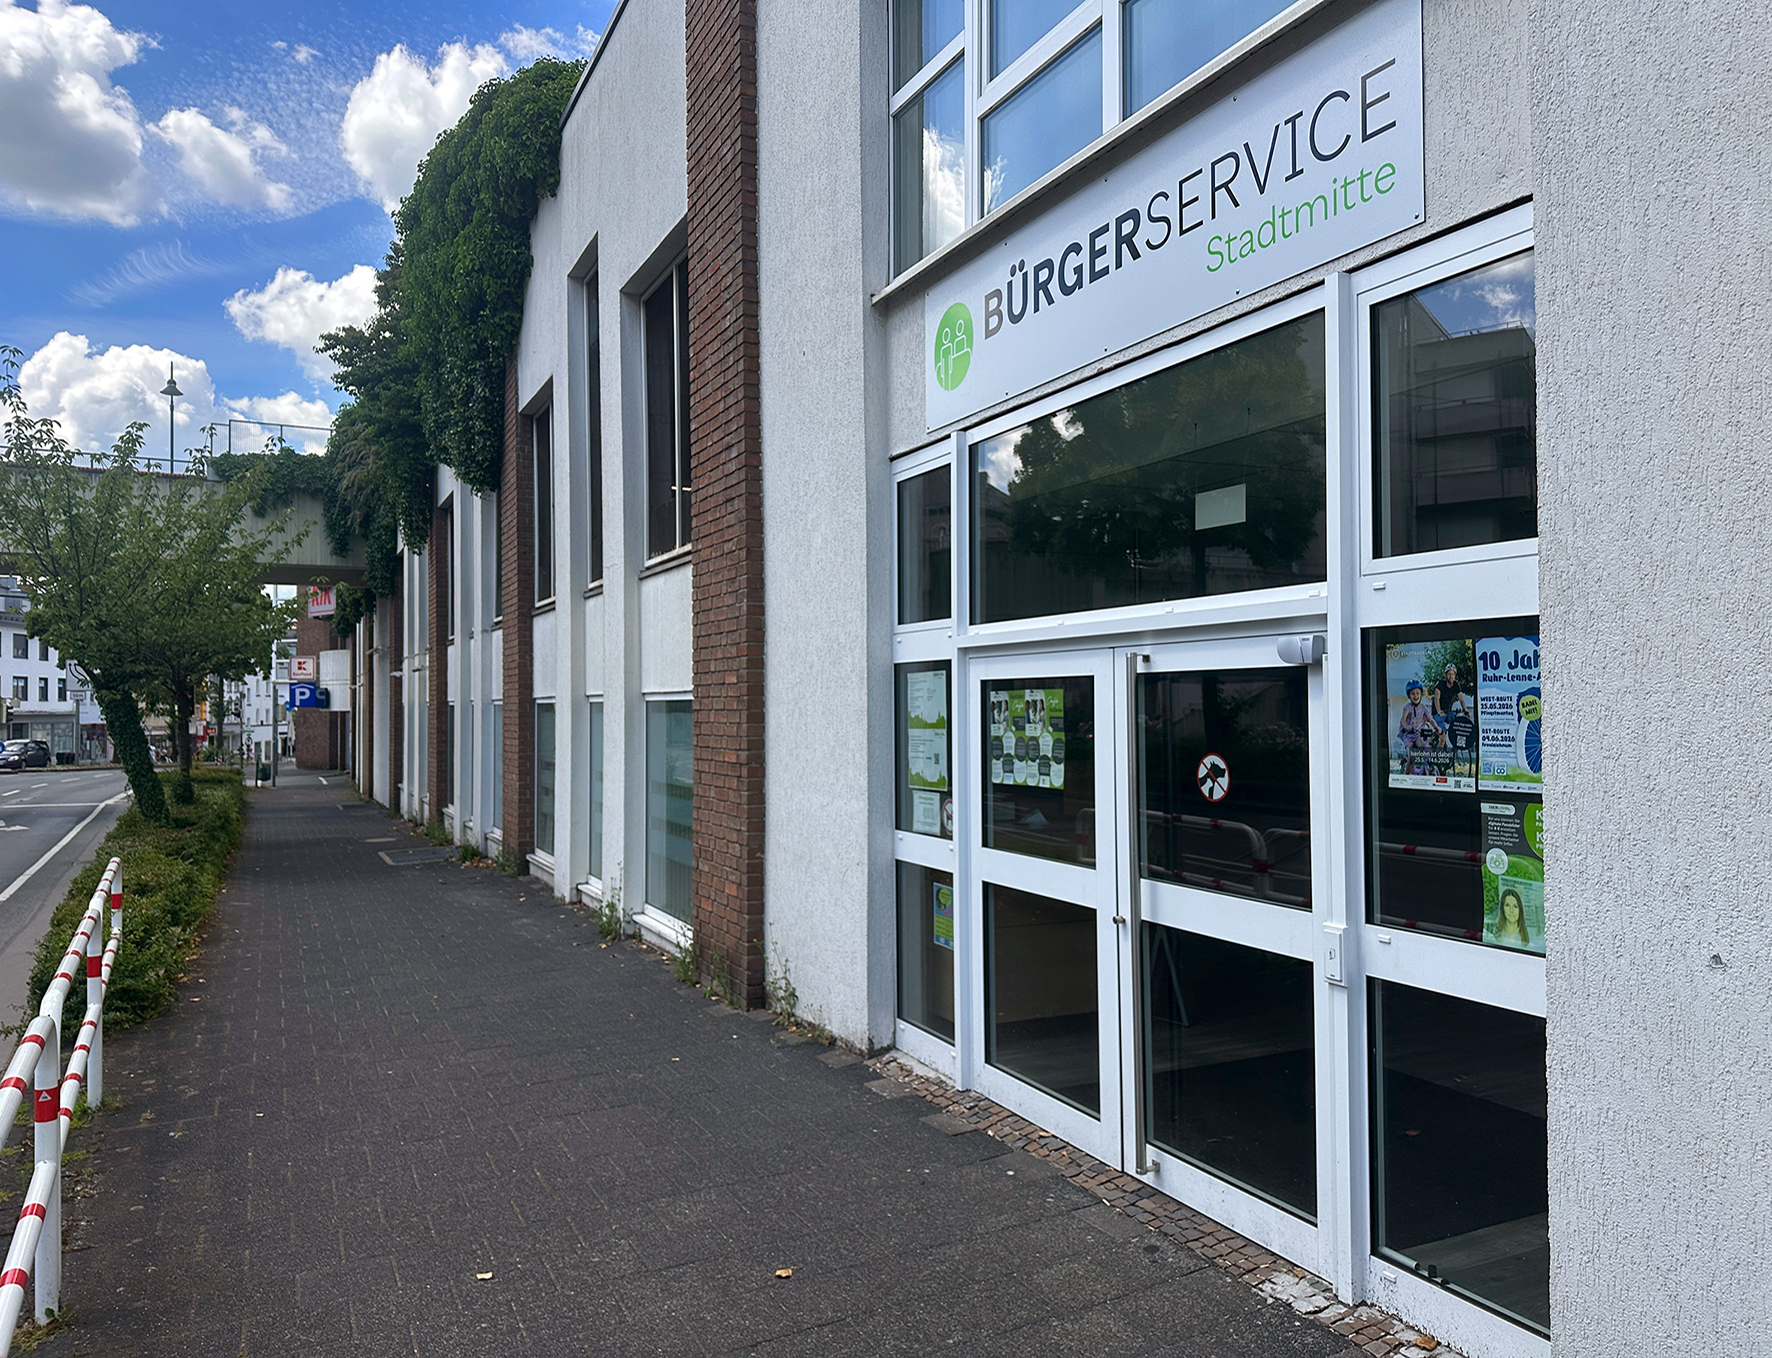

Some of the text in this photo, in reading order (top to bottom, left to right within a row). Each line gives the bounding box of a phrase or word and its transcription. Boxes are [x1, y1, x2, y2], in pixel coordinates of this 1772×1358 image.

[984, 58, 1397, 341] BÜRGERSERVICE
[1206, 162, 1397, 273] Stadtmitte
[1478, 650, 1501, 671] 10
[295, 688, 311, 706] P
